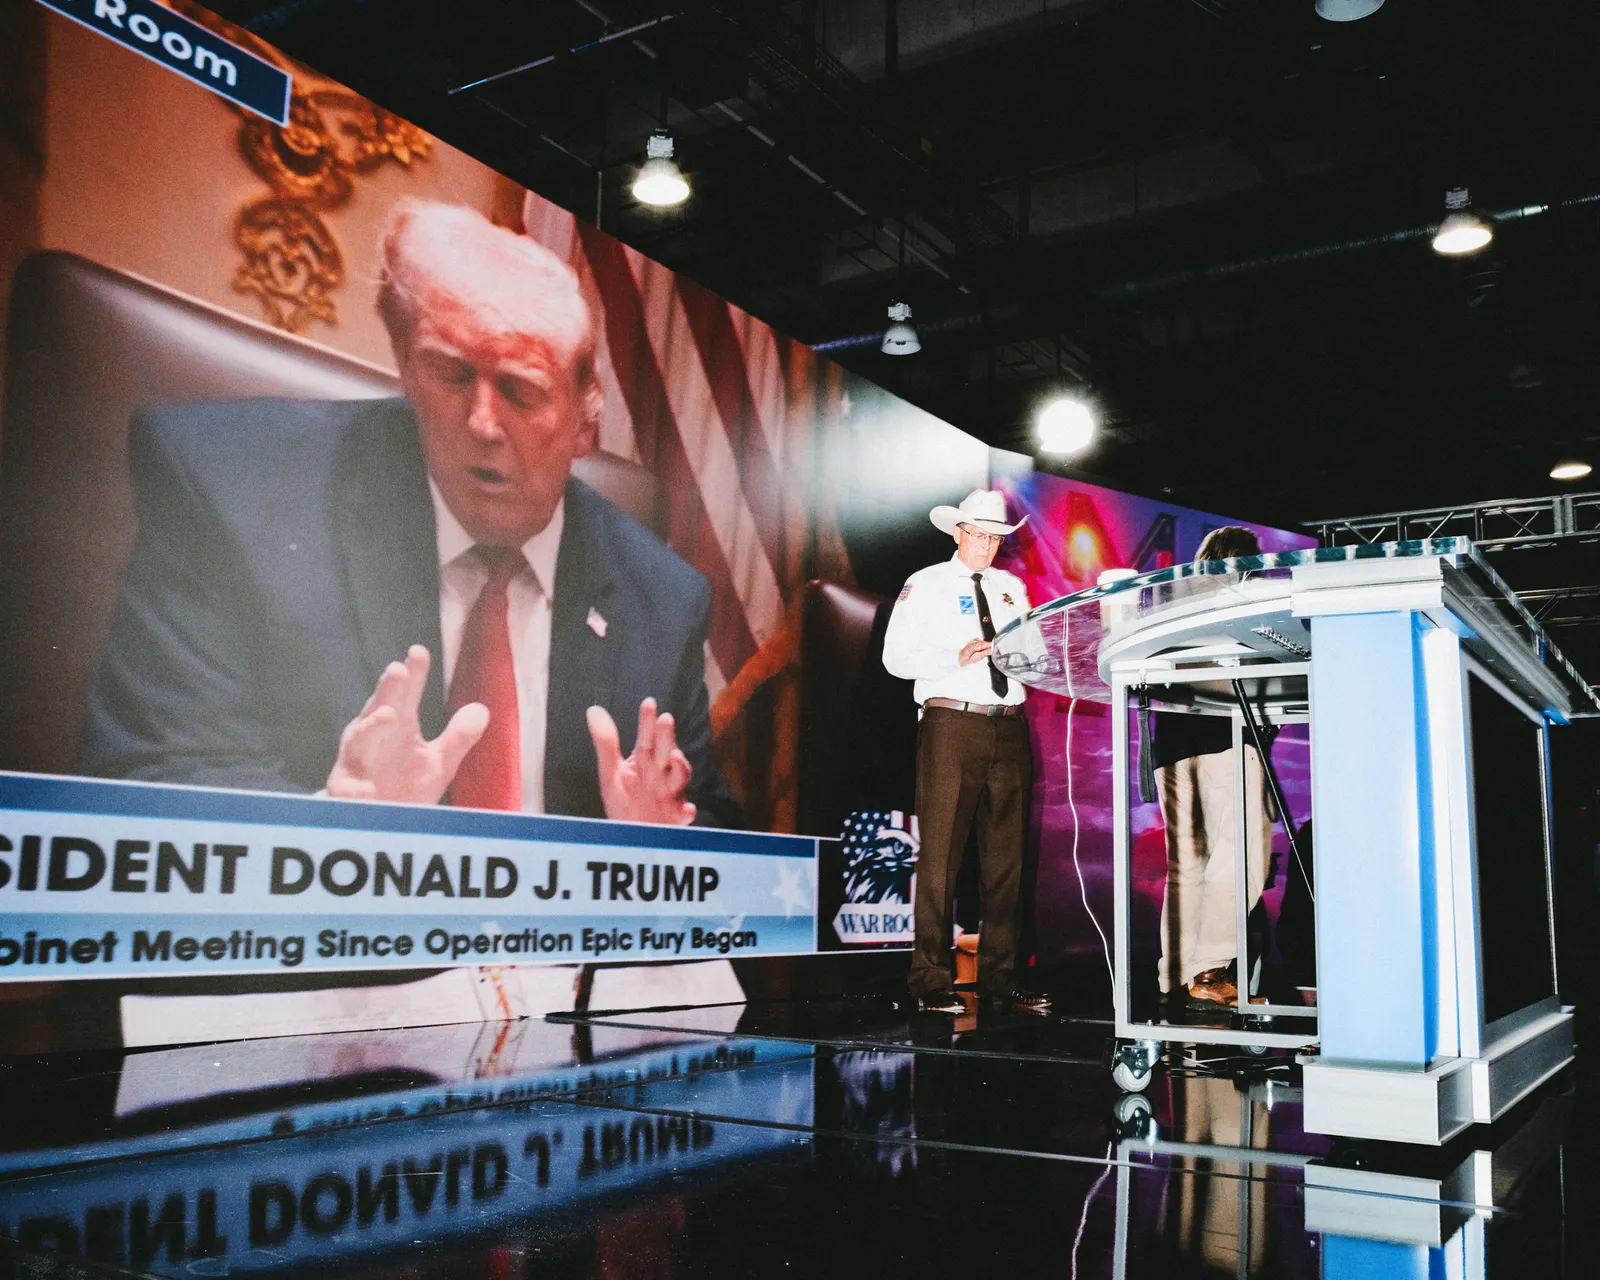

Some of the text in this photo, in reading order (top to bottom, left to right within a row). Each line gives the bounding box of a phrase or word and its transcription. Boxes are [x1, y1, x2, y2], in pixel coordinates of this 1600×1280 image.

[95, 0, 237, 86] Room
[270, 847, 519, 899] DONALD
[533, 860, 571, 900] J.
[586, 861, 720, 903] TRUMP
[133, 930, 305, 967] Meeting
[317, 929, 414, 959] Since
[424, 928, 572, 961] Operation
[581, 928, 631, 957] Epic
[640, 927, 686, 955] Fury
[691, 927, 757, 954] Began
[840, 913, 880, 934] WAR
